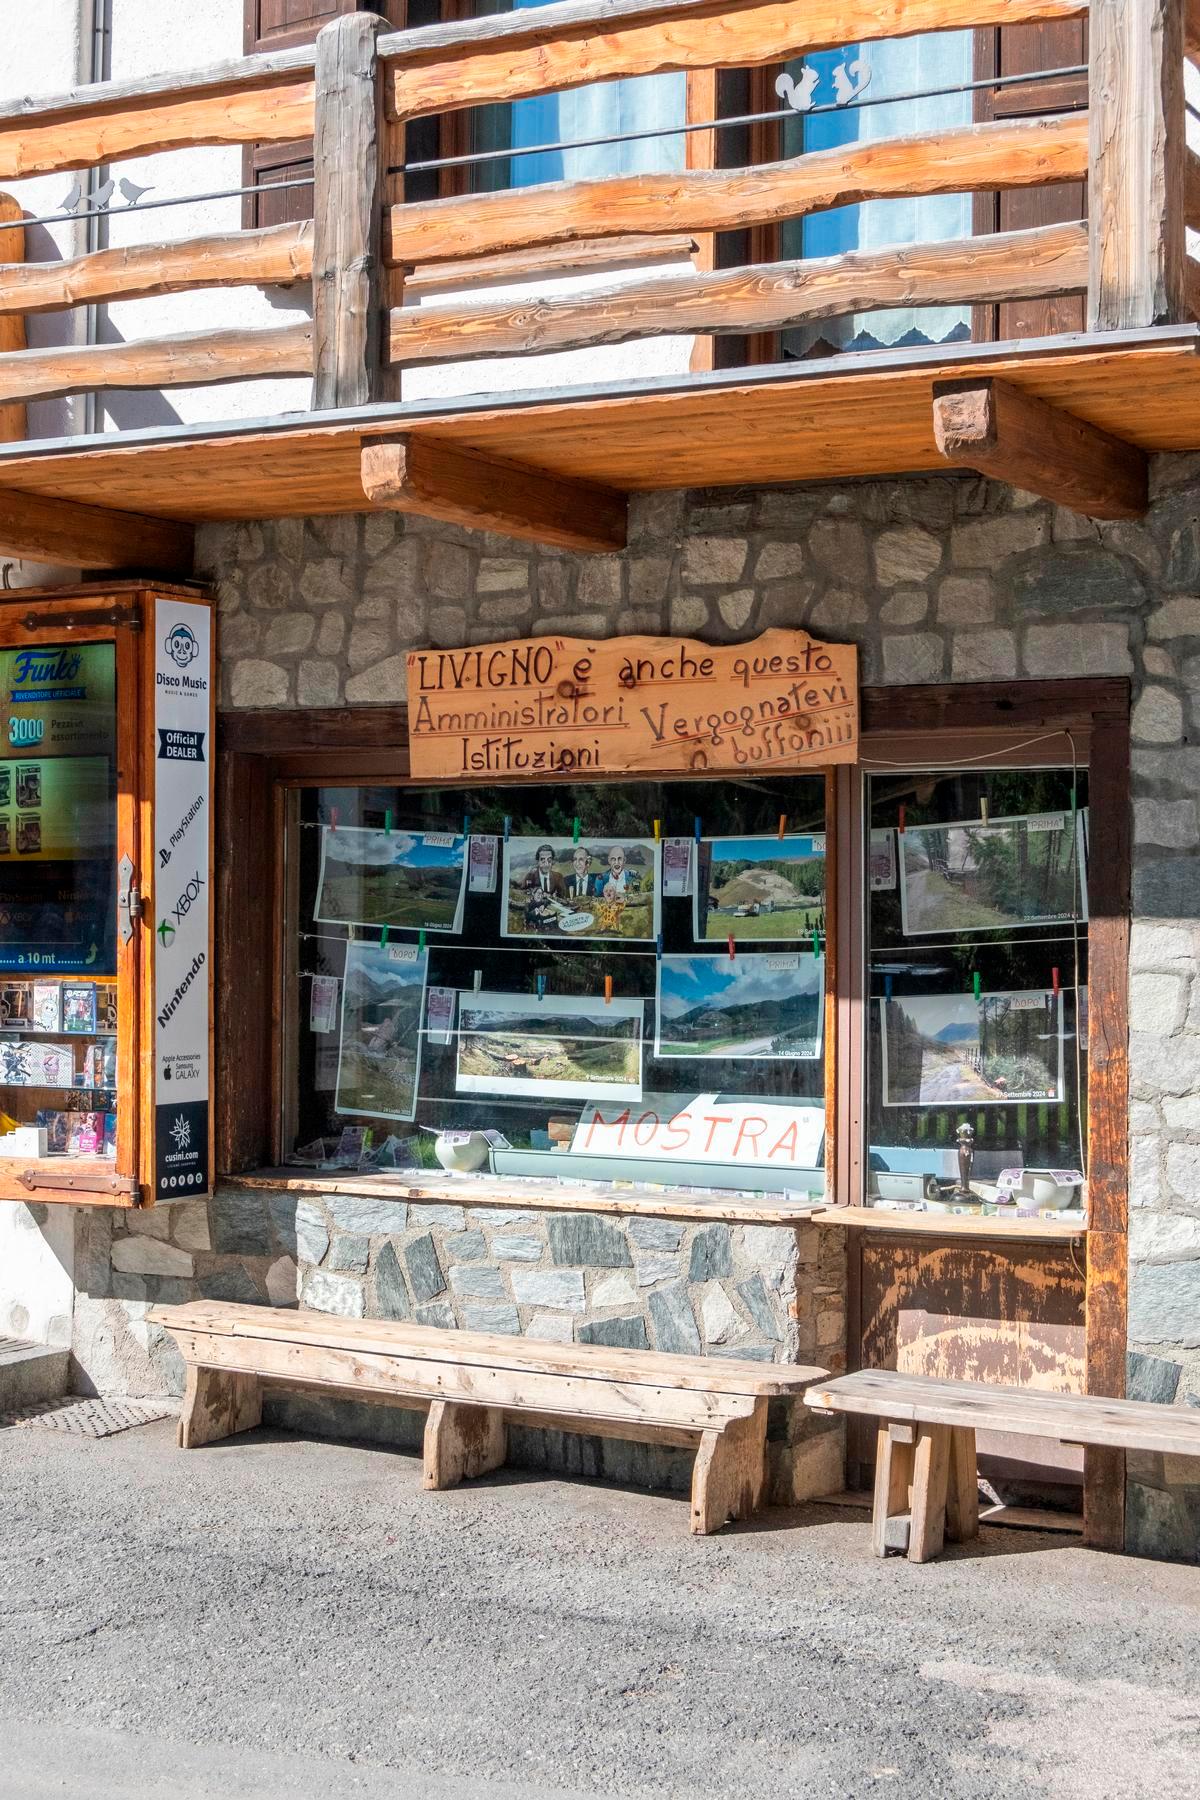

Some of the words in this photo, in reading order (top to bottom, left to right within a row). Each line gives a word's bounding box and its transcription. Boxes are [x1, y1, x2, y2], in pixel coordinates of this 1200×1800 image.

[15, 650, 83, 684] Funko
[156, 672, 180, 687] Disco
[182, 675, 207, 690] Music
[618, 645, 714, 684] anche
[733, 642, 832, 688] questo
[413, 687, 625, 732] Amministratori
[640, 677, 849, 746] Vergognatevi
[8, 716, 44, 744] 3000
[166, 732, 198, 745] Official
[166, 745, 198, 759] DEALER
[461, 736, 600, 772] Istituzioni
[169, 795, 205, 847] PlayStation
[171, 871, 205, 925] XBOX
[18, 954, 25, 964] a
[27, 952, 40, 964] 10
[41, 952, 56, 964] mt
[157, 952, 206, 1029] Nintendo
[162, 1055, 175, 1063] Apple
[176, 1054, 201, 1062] Accessories
[175, 1069, 200, 1080] GALAXY
[584, 1108, 799, 1161] MOSTRA
[165, 1151, 199, 1163] cusini.com
